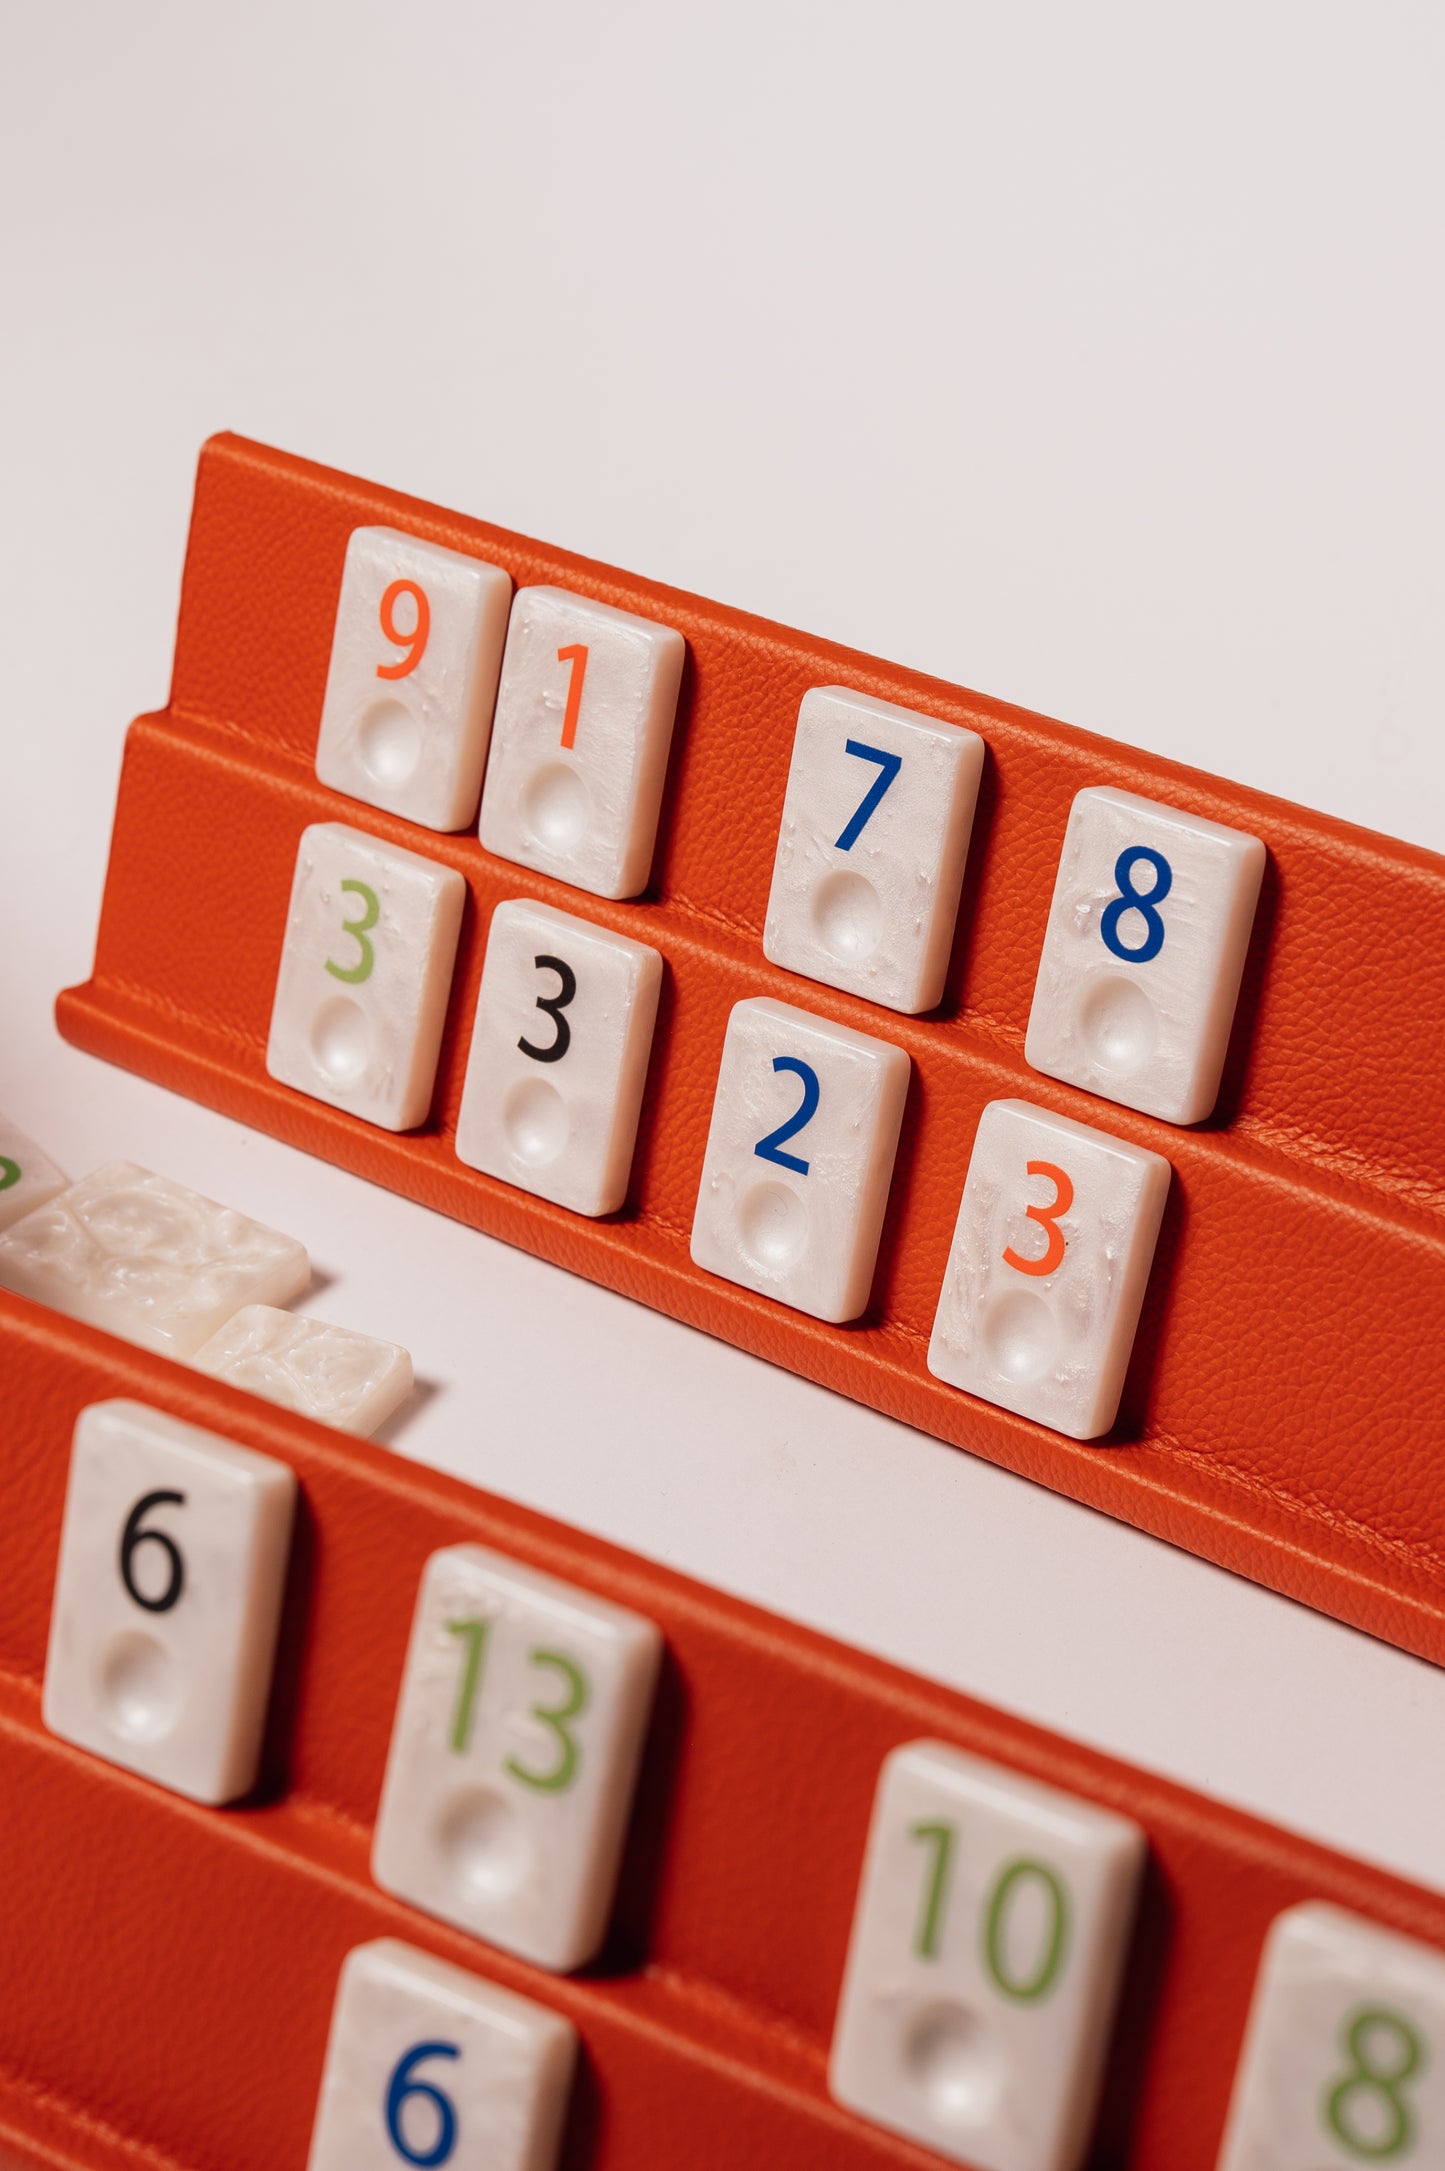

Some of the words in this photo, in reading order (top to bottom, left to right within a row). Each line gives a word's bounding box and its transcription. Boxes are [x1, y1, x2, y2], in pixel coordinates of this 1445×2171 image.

[376, 579, 431, 681] 9
[557, 643, 589, 750] 1
[835, 739, 902, 852] 7
[323, 879, 379, 983] 3
[1101, 846, 1172, 963] 8
[517, 954, 577, 1062] 3
[754, 1056, 820, 1175] 2
[1002, 1160, 1074, 1277] 3
[119, 1489, 186, 1614] 6
[445, 1617, 590, 1794] 13
[911, 1820, 1069, 2003] 10
[385, 2042, 459, 2169] 6
[1322, 2006, 1423, 2160] 8
